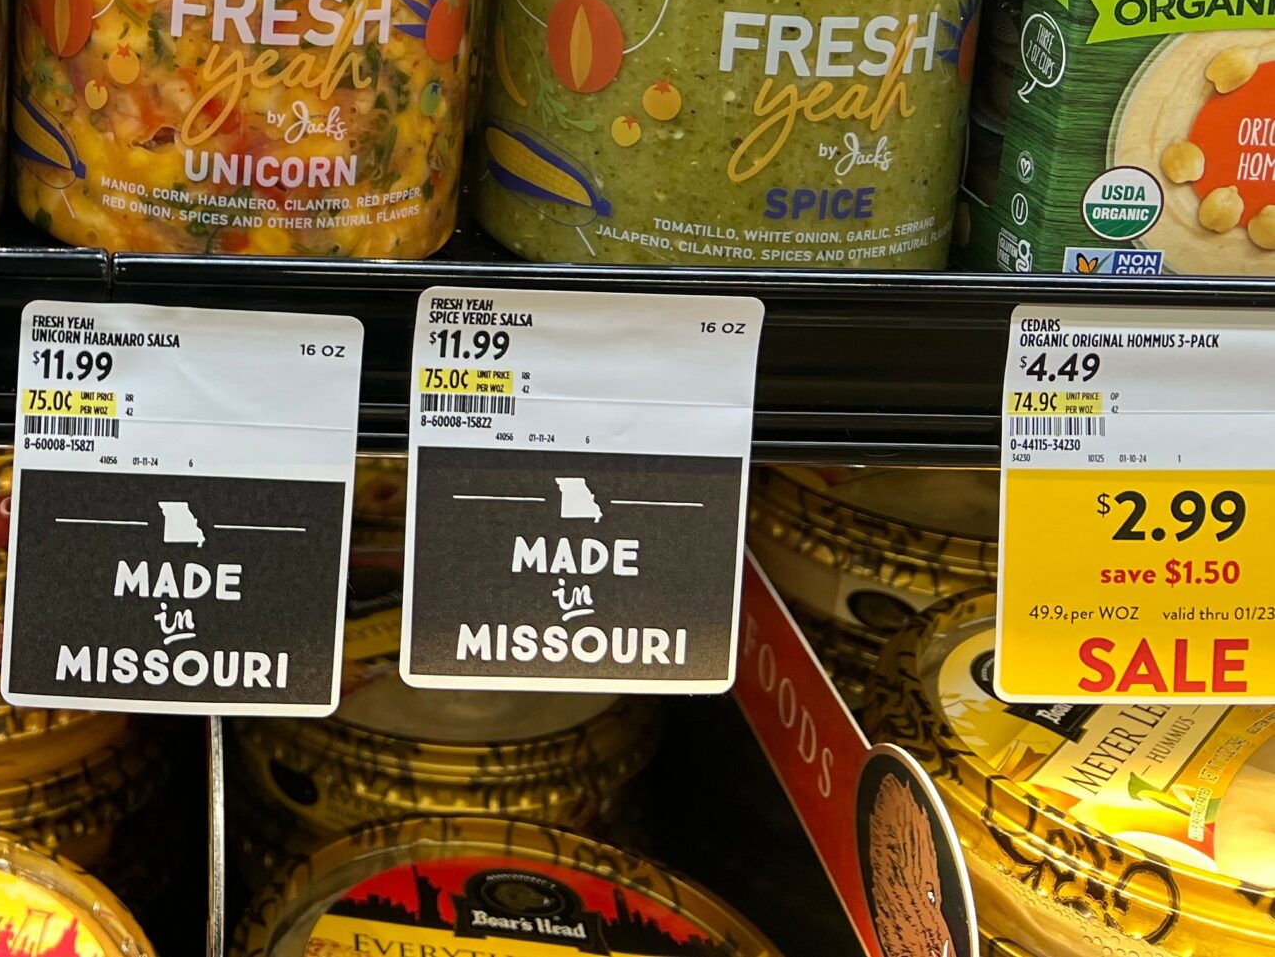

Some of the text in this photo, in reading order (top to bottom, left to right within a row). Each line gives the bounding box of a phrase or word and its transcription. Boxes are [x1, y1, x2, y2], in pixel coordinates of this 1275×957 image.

[719, 11, 938, 78] FRESH
[727, 22, 916, 183] yeah
[267, 100, 347, 144] by Jack's
[184, 150, 357, 187] UNICORN
[819, 132, 892, 177] by Jack's
[763, 187, 875, 221] SPICE
[1101, 185, 1146, 202] USDA
[1092, 207, 1149, 221] ORGANIC
[429, 311, 533, 327] SPICE VERDE SALSA
[431, 298, 493, 311] FRESH YEAH
[32, 329, 180, 348] UNICORN HABANARO SALSA
[1020, 334, 1219, 348] ORGANIC ORIGINAL HOMMUS 3-PACK
[1021, 319, 1060, 331] CEDARS
[430, 330, 509, 361] $11.99
[33, 349, 113, 381] $11.99
[1020, 352, 1100, 382] $4.49
[421, 415, 492, 428] 8-60008-15822
[1010, 439, 1081, 451] 0-44115-34230
[1097, 491, 1246, 542] $2.99
[512, 536, 639, 576] MADE
[114, 560, 242, 600] MADE
[1100, 559, 1240, 587] save $1.50
[1099, 606, 1139, 620] WOZ
[1163, 607, 1275, 621] valid thru 01/23
[456, 624, 686, 665] MISSOURI
[55, 645, 288, 688] MISSOURI
[1078, 637, 1249, 693] SALE
[744, 614, 833, 799] FOODS
[1146, 715, 1195, 764] HUMMUS
[1062, 726, 1146, 795] MEYER
[536, 916, 587, 939] Head
